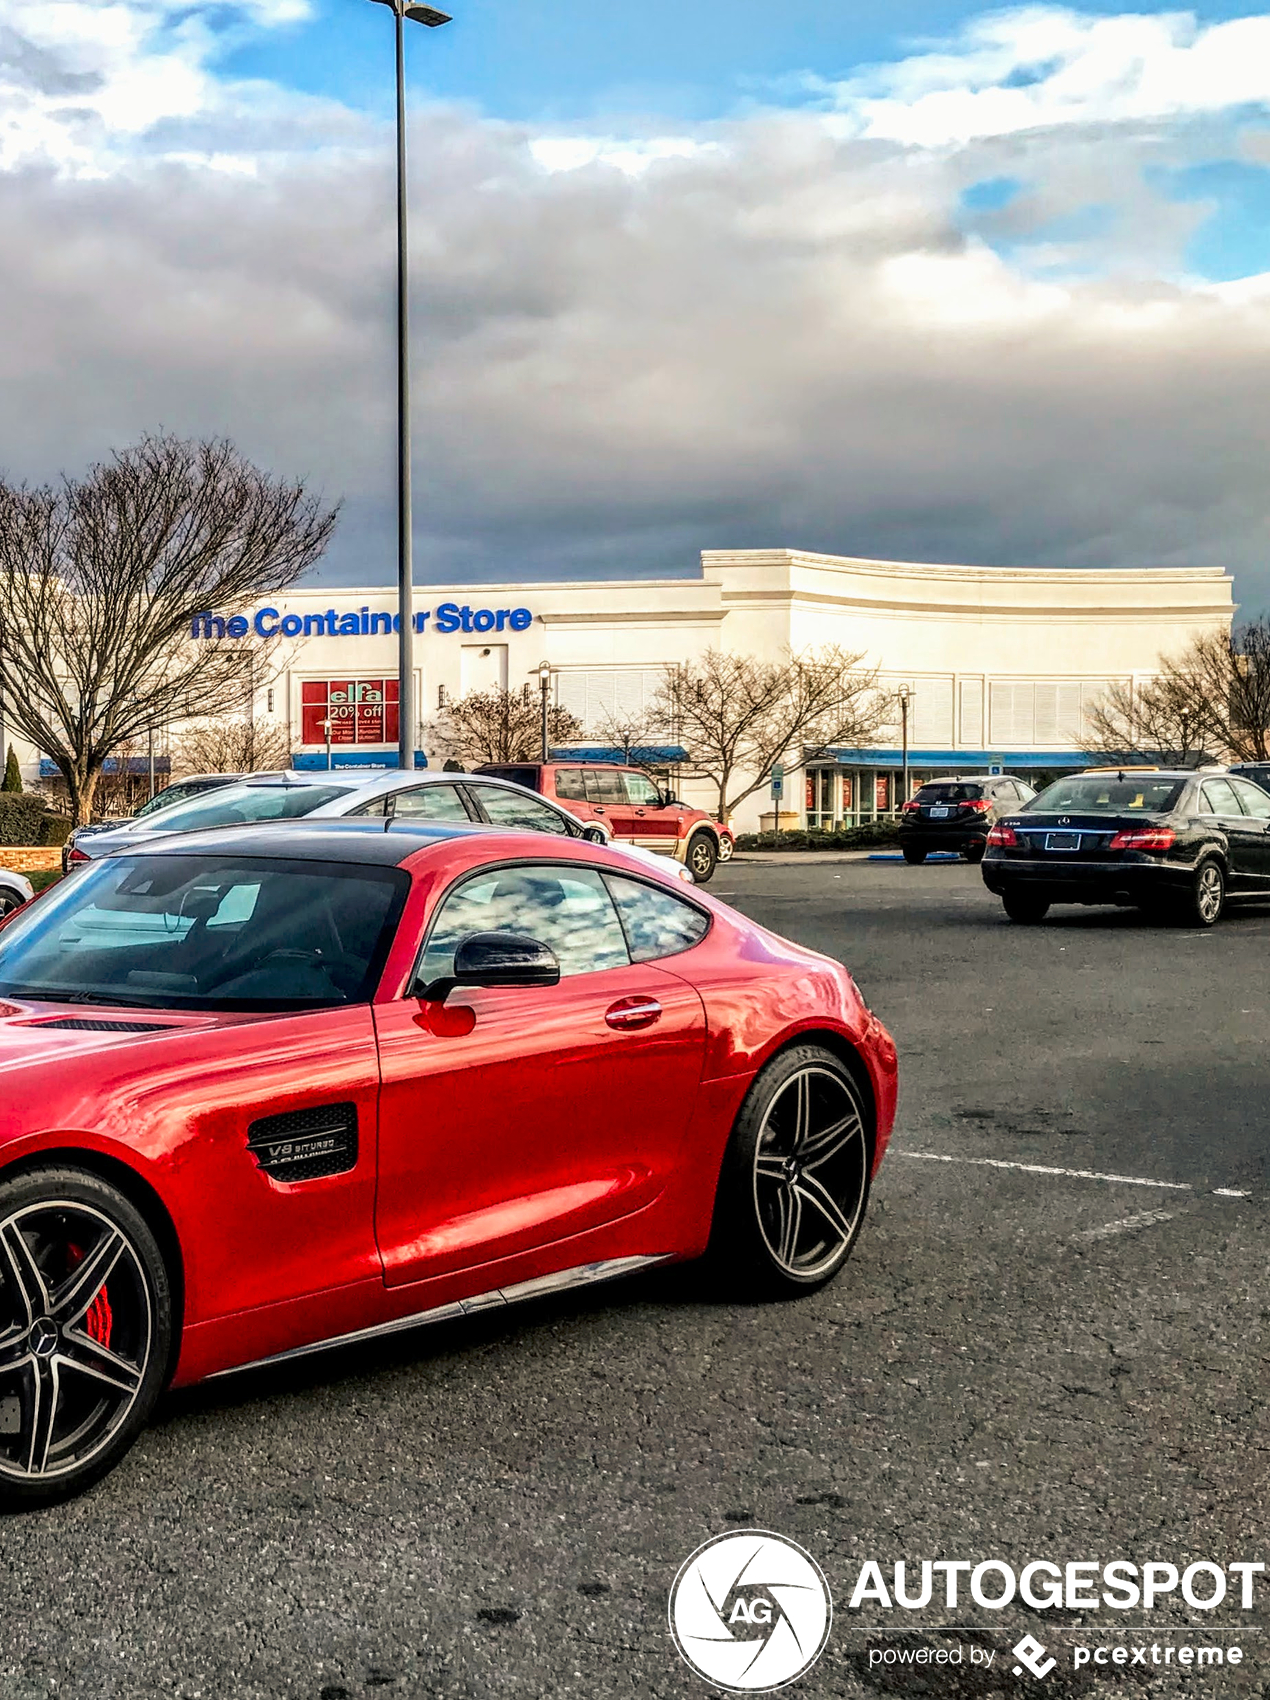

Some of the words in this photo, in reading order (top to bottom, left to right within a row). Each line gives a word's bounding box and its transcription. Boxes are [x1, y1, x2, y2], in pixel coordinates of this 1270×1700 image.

[190, 611, 249, 639] The
[435, 602, 533, 633] Store
[330, 683, 382, 702] elfa
[330, 706, 360, 718] 20%
[363, 705, 382, 717] off
[269, 1144, 292, 1157] V8
